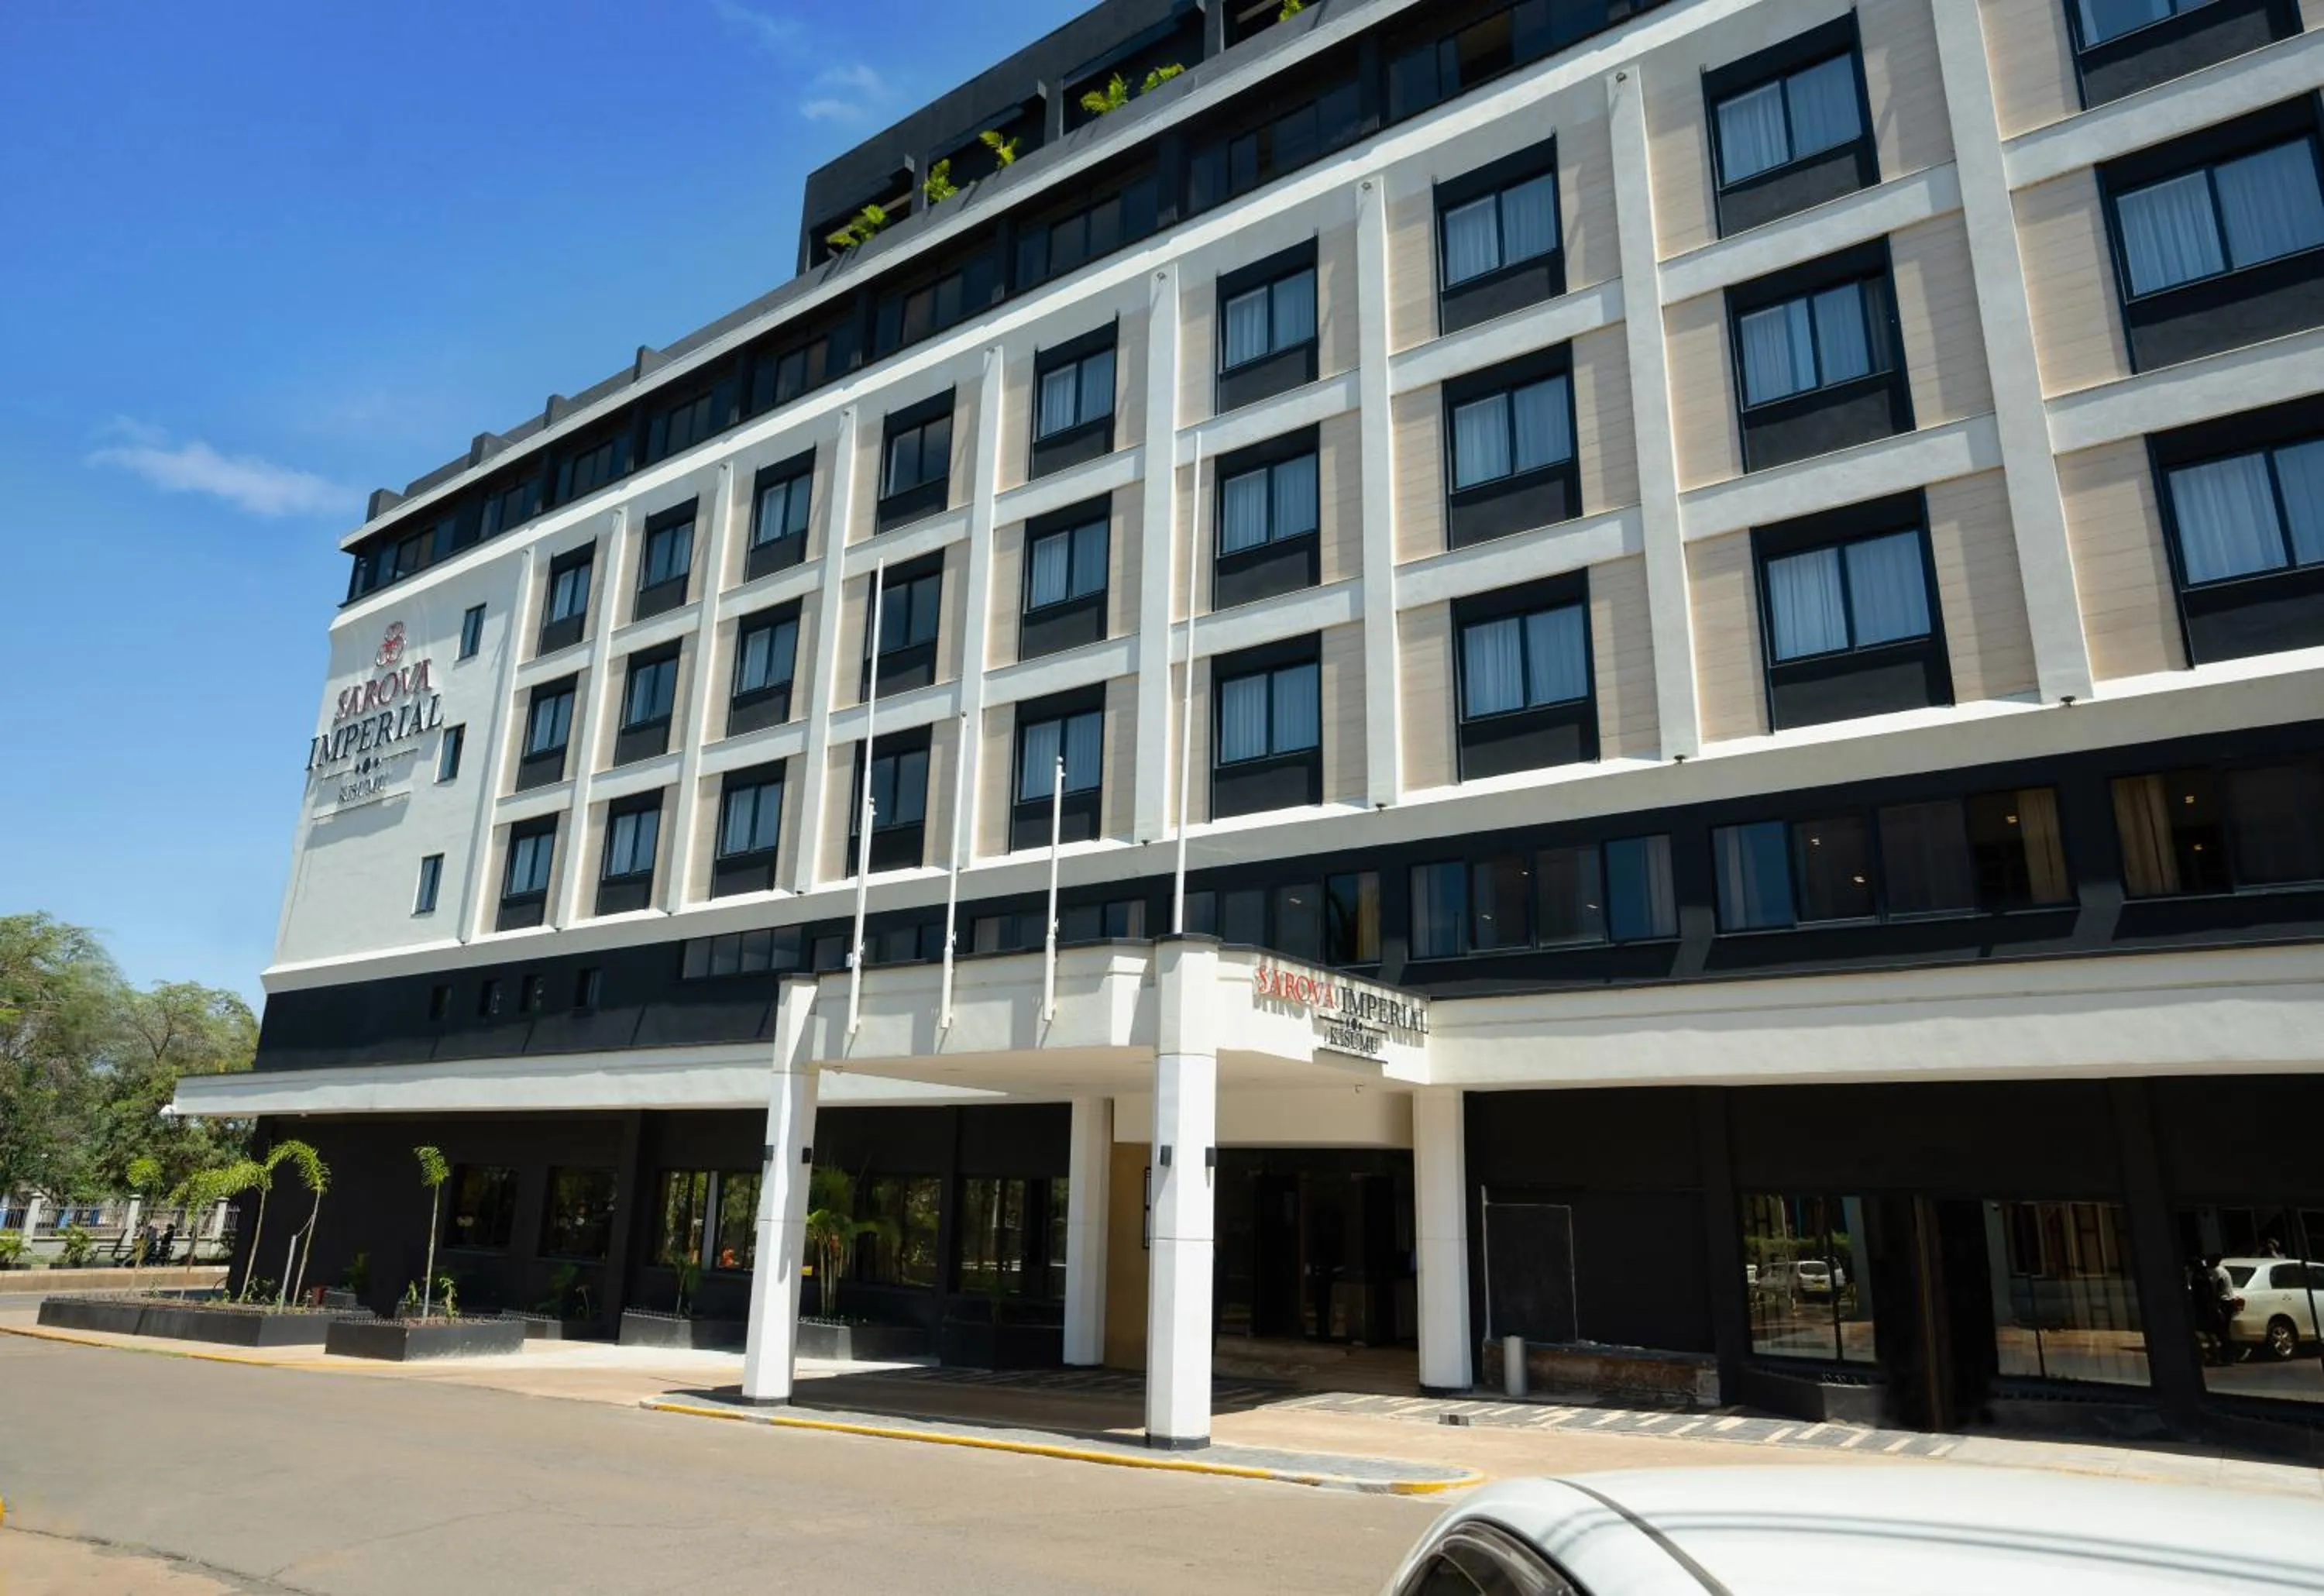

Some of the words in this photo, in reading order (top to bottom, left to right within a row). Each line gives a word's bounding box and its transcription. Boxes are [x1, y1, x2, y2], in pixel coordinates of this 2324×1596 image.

[336, 659, 433, 720] SAROVA
[305, 694, 442, 771] IMPERIAL
[1257, 965, 1336, 1009] SAROVA
[1340, 986, 1429, 1034] IMPERIAL
[1329, 1026, 1379, 1054] KISUMU
